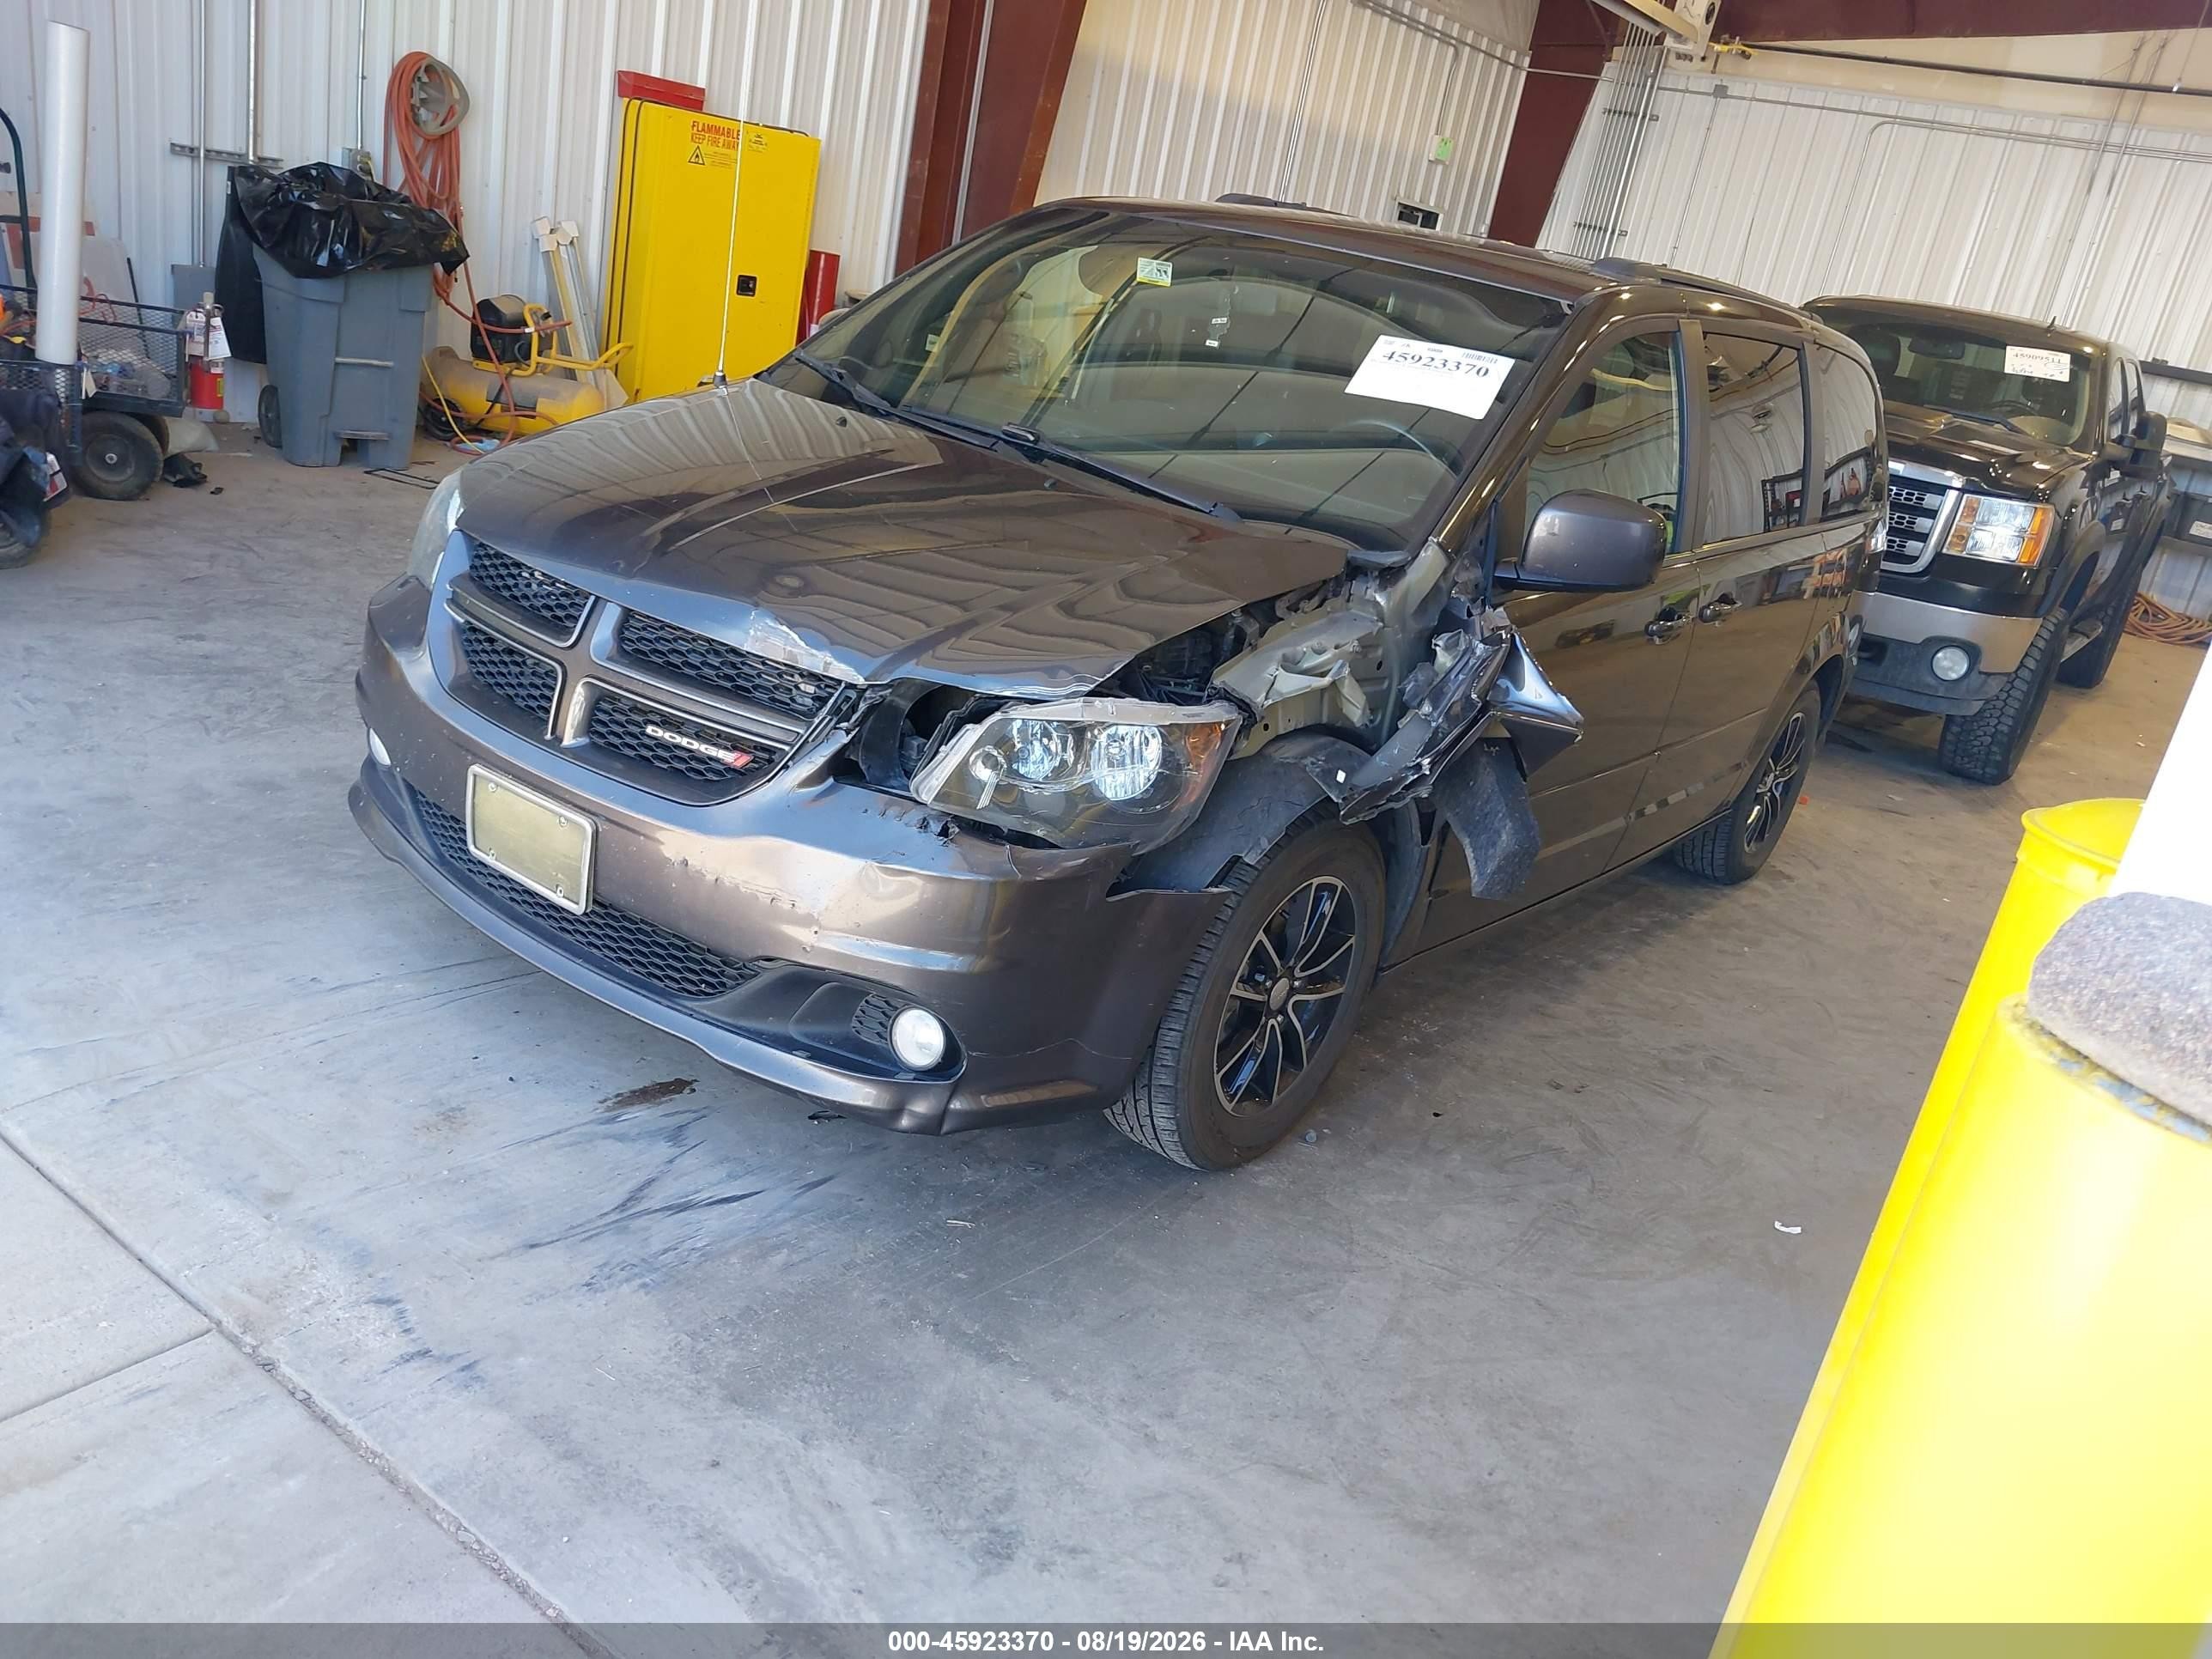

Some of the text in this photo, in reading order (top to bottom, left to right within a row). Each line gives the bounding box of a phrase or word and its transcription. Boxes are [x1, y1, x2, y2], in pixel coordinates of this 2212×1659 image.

[691, 121, 741, 140] FLAMMABLE
[707, 136, 721, 148] FIRE
[1382, 351, 1489, 377] 45923370
[646, 726, 737, 763] DODGE
